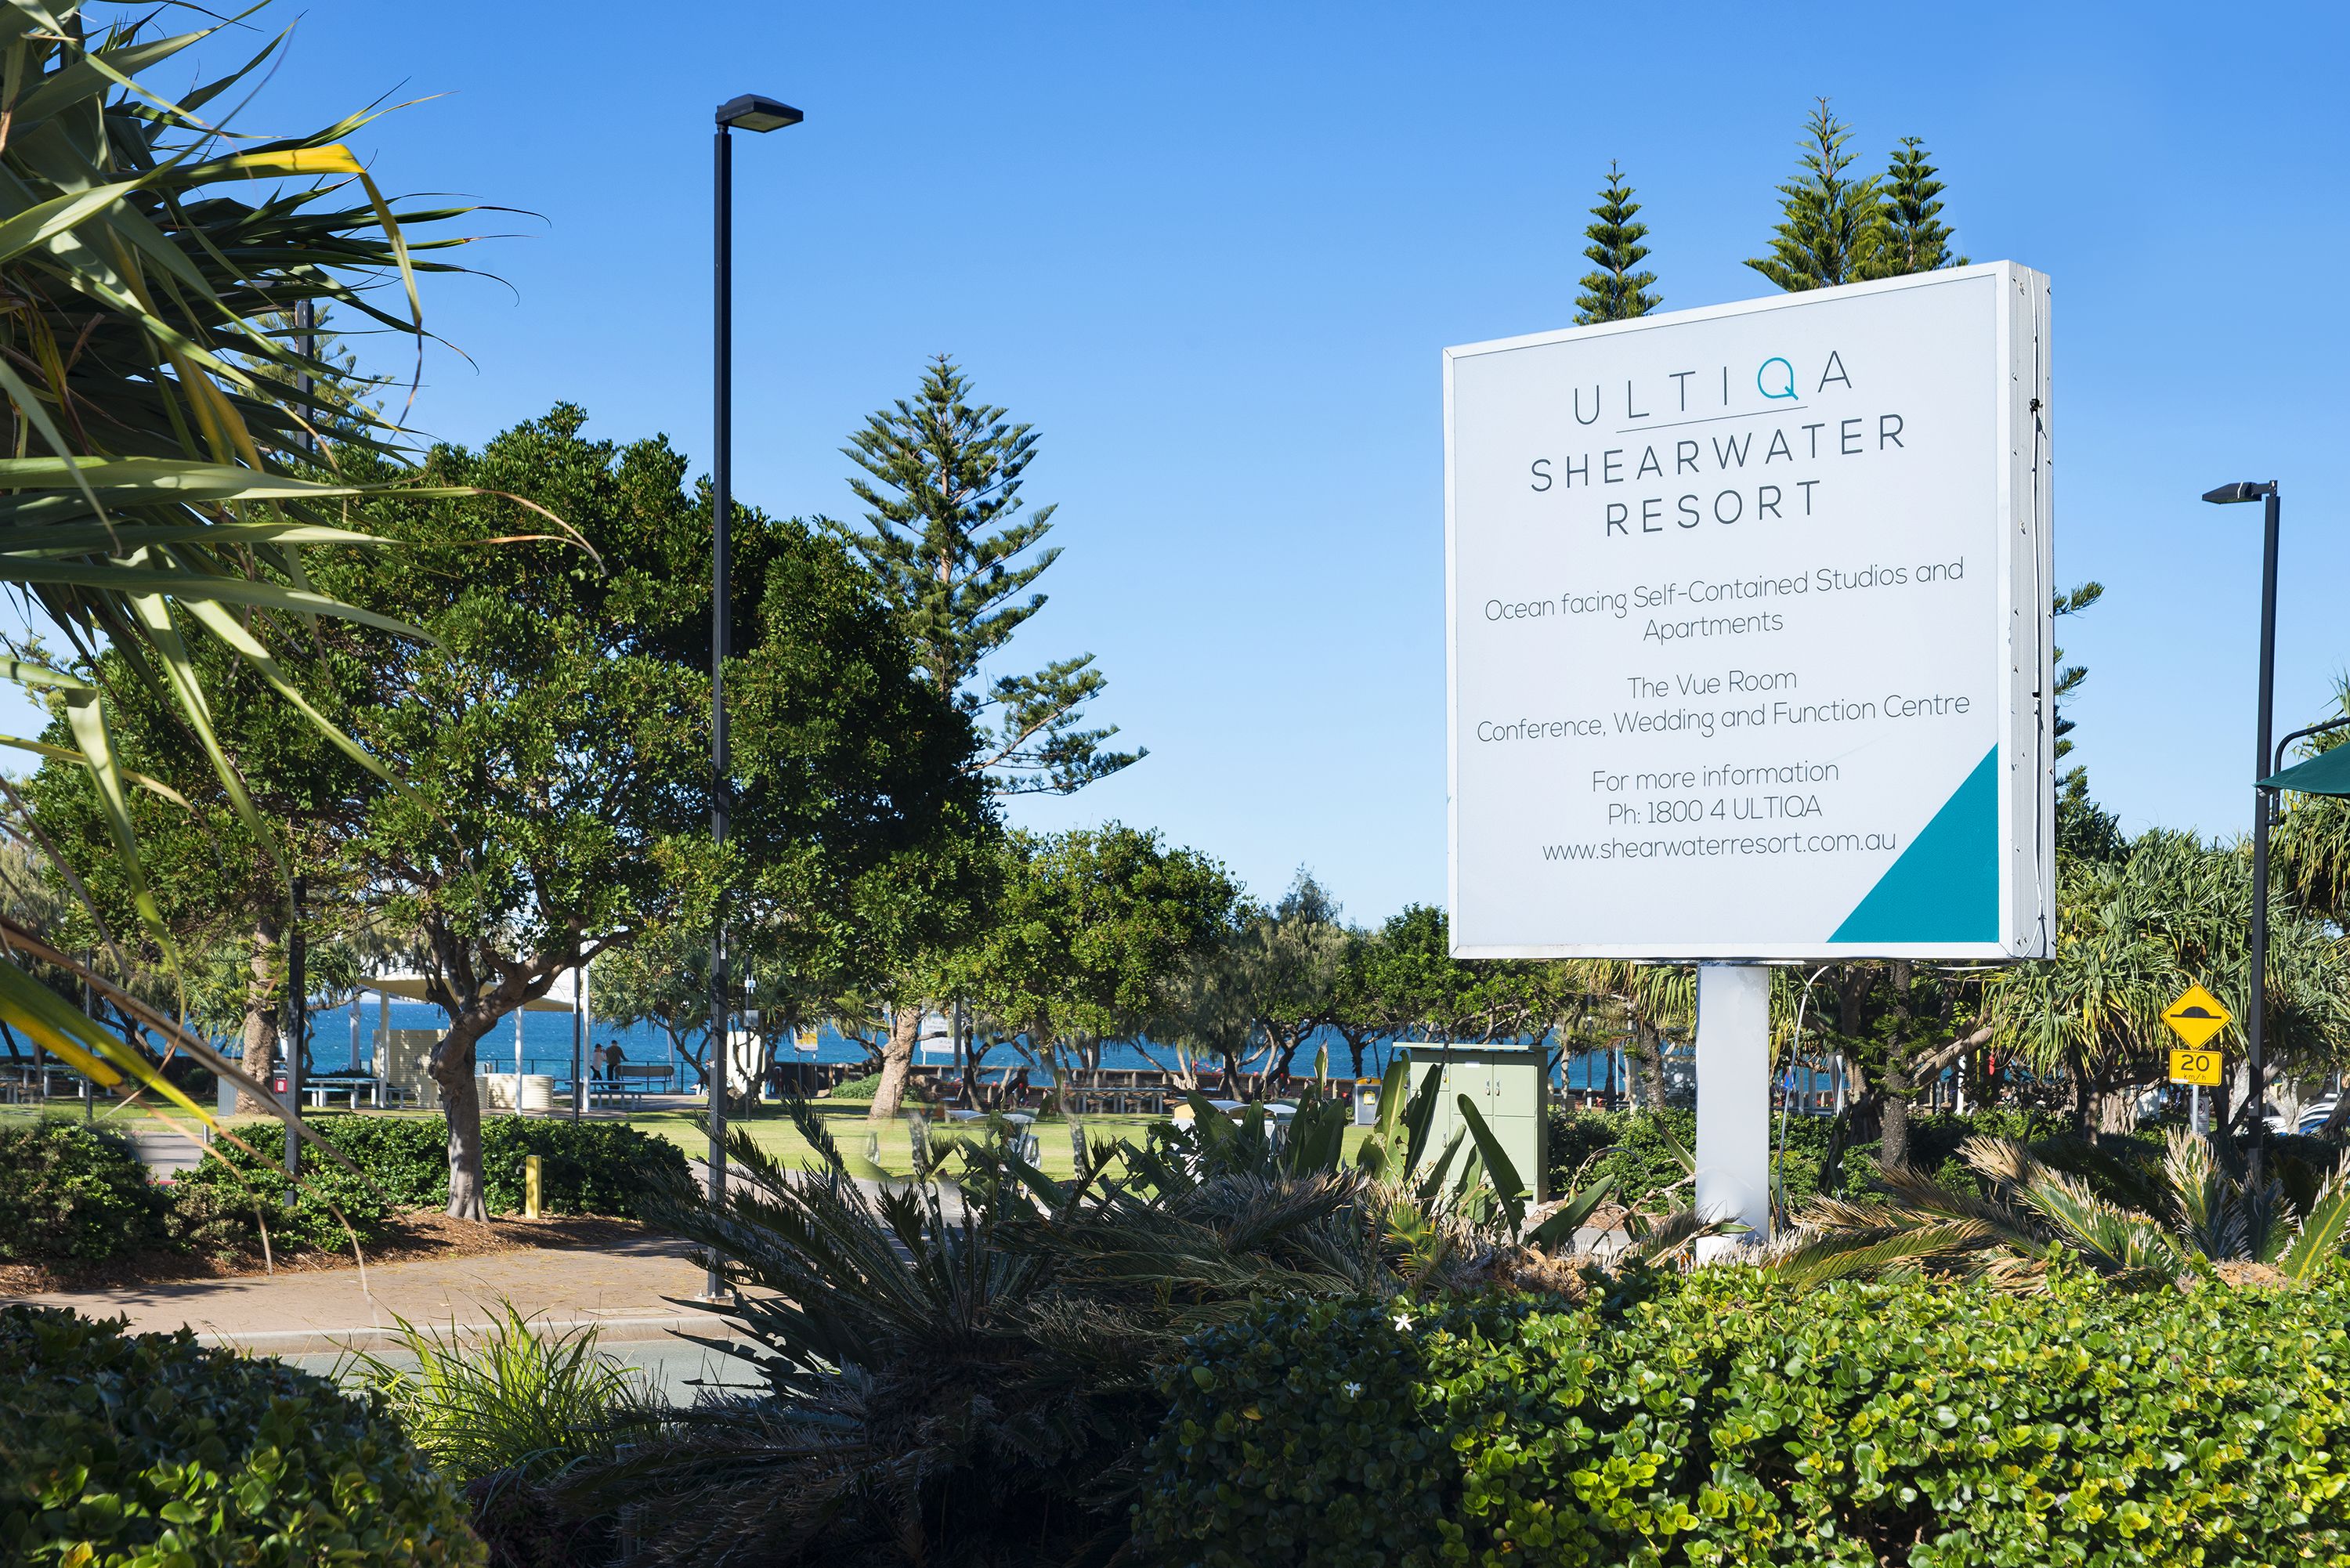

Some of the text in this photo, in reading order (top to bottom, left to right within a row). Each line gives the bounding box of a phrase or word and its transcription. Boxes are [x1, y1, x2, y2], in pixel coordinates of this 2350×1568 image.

[1574, 350, 1853, 426] ULTIQA
[1531, 414, 1905, 493] SHEARWATER
[1607, 479, 1820, 537] RESORT
[1484, 555, 1964, 621] Ocean facing Self-Contained Studios and
[1643, 611, 1784, 646] Apartments
[1626, 670, 1797, 699] The Vue Room
[1477, 693, 1970, 742] Conference, Wedding and Function Centre
[1593, 761, 1839, 793] For more information
[1608, 794, 1823, 826] Ph: 1800 4 ULTIQA
[1542, 833, 1896, 861] www.shearwaterresort.com.au
[2181, 1054, 2210, 1071] 20
